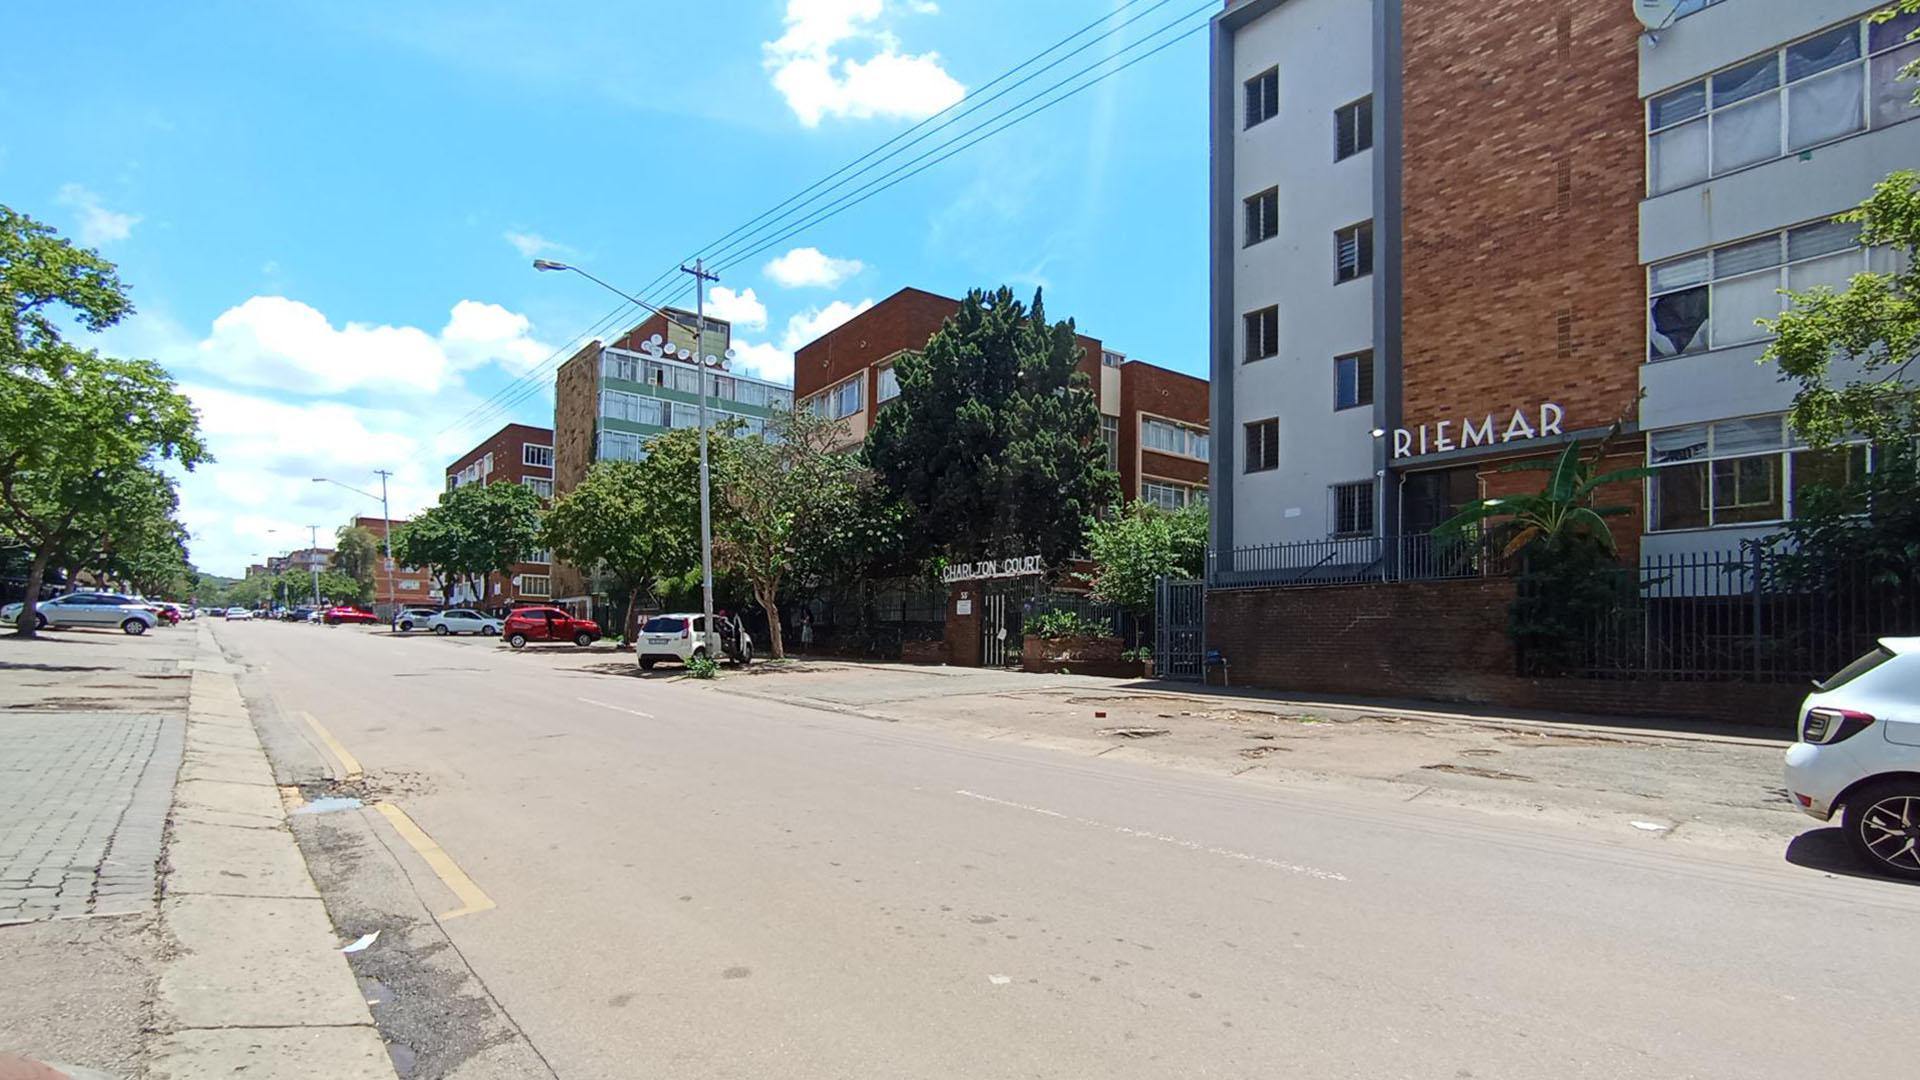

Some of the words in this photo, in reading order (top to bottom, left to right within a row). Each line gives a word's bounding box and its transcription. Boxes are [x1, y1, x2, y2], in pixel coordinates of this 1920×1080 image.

[1393, 403, 1565, 459] RIEMAR
[943, 560, 997, 581] CHARLTON
[1004, 555, 1042, 574] COURT
